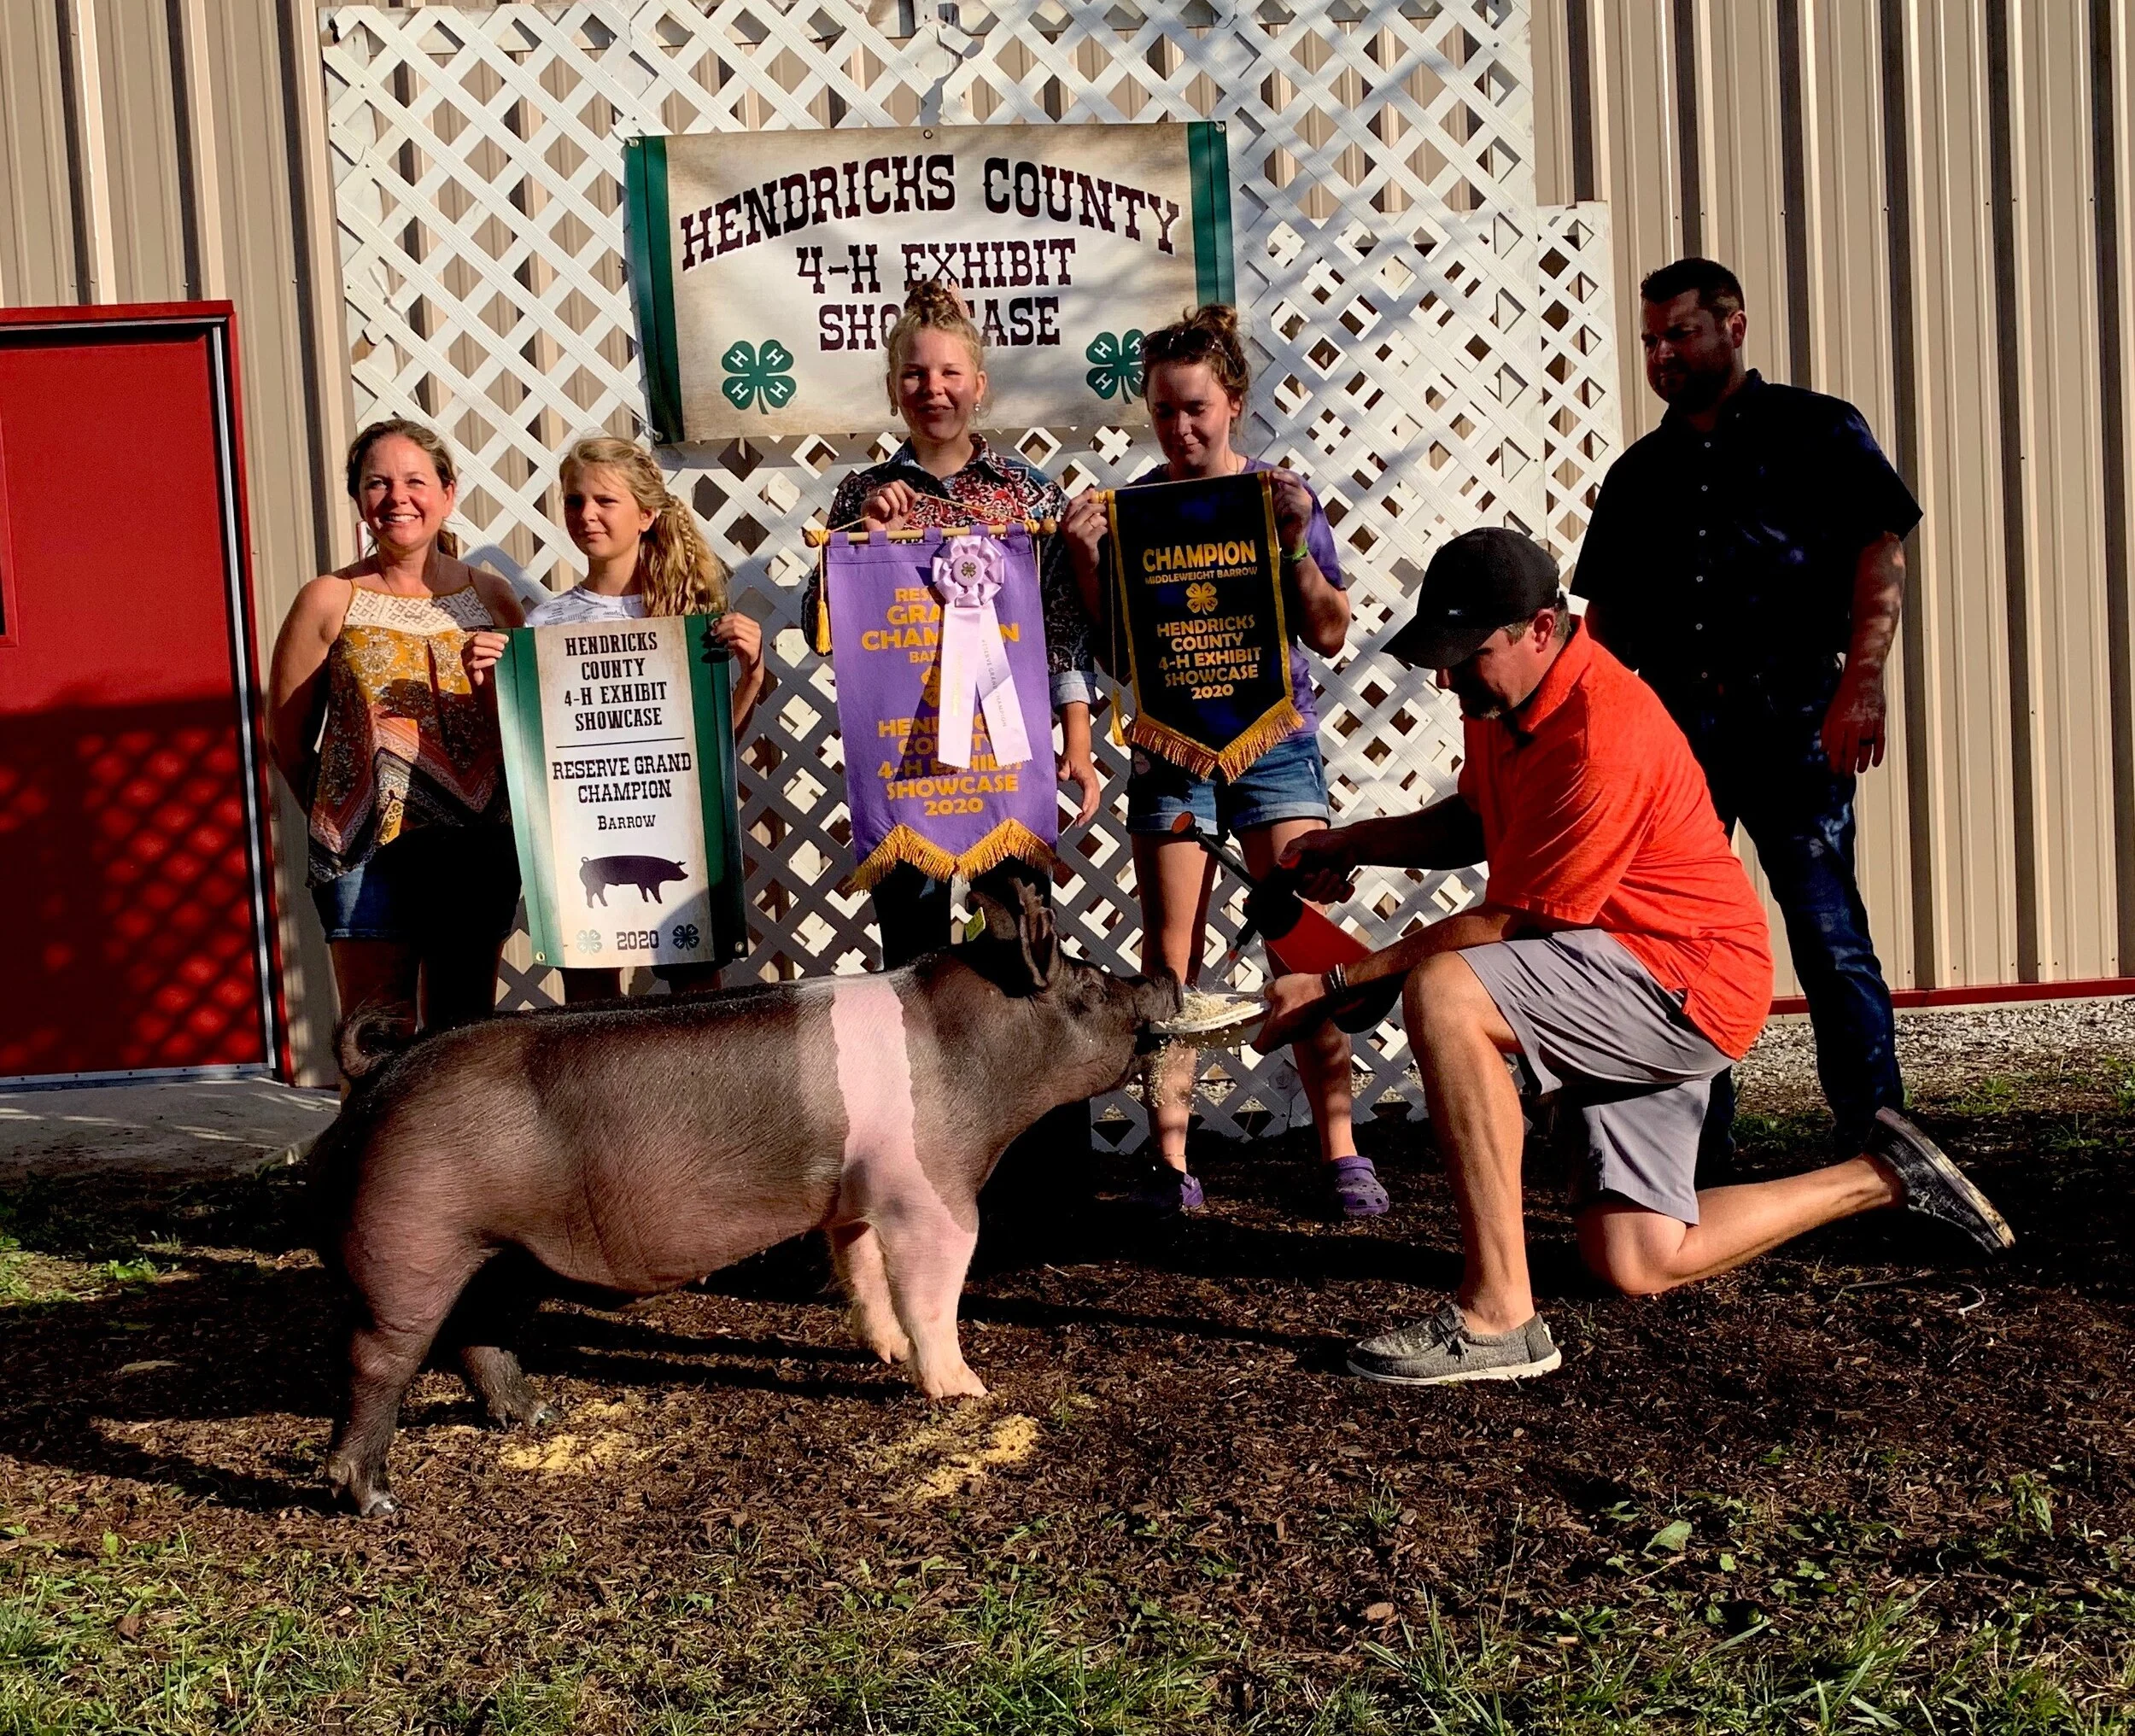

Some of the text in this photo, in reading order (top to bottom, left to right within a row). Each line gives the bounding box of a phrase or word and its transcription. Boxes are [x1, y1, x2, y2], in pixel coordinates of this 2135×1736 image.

[681, 155, 1179, 267] HENDRICKS COUNTY
[796, 238, 1076, 294] 4-H EXHIBIT
[819, 296, 1060, 351] SHOASE
[1143, 540, 1256, 572] CHAMPION
[1145, 566, 1257, 584] MIDDLEWEIGHT BARROW
[886, 604, 943, 624] GRA
[1156, 614, 1255, 638] HENDRICKS
[564, 632, 658, 656] HENDRICKS
[861, 623, 1021, 651] CHAMN
[1171, 632, 1243, 652] COUNTY
[582, 658, 646, 680] COUNTY
[1158, 646, 1261, 670] 4-H EXHIBIT
[1165, 663, 1259, 687] SHOWCASE
[564, 681, 667, 706] 4-H EXHIBIT
[1190, 683, 1234, 700] 2020
[575, 707, 662, 731] SHOWCASE
[552, 752, 692, 780] RESERVE GRAND
[877, 759, 923, 779] 4-H
[578, 779, 672, 804] CHAMPION
[886, 774, 1019, 800] SHOWCASE
[923, 797, 984, 816] 2020
[598, 815, 656, 830] BARROW
[617, 930, 659, 950] 2020
